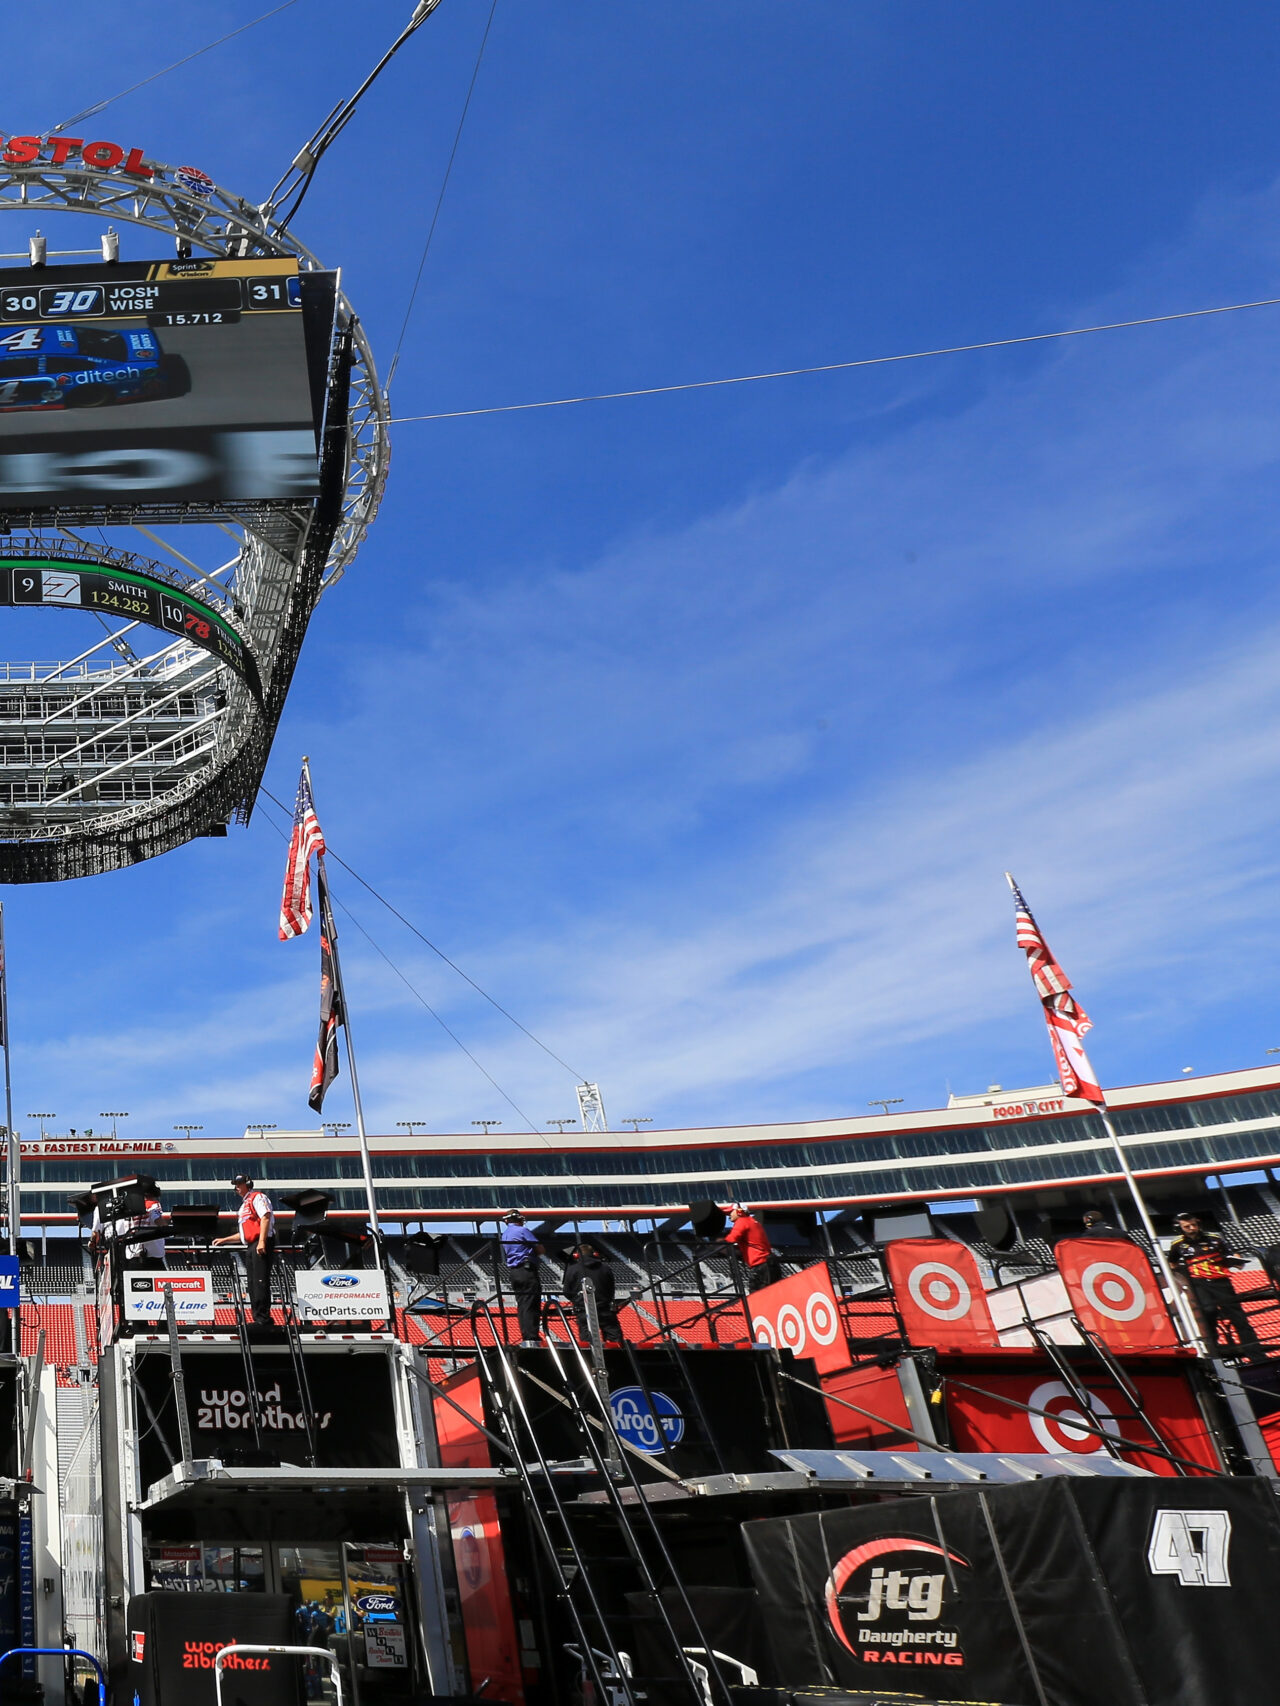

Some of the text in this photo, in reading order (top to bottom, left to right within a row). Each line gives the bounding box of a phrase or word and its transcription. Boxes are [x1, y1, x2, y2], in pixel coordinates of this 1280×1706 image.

[172, 263, 198, 272] Sprint
[109, 287, 159, 299] JOSH
[253, 285, 280, 300] 31
[6, 297, 36, 311] 30
[47, 291, 98, 314] 30
[111, 299, 154, 311] WISE
[166, 313, 223, 325] 15.712
[0, 328, 42, 350] 4
[75, 367, 140, 384] ditech
[22, 578, 34, 592] 9
[108, 580, 148, 598] SMITH
[91, 591, 150, 615] 124.282
[165, 605, 182, 622] 10
[185, 613, 210, 638] 78
[993, 1105, 1023, 1118] FOOD
[1039, 1100, 1064, 1112] CITY
[44, 1143, 96, 1153] FASTEST
[99, 1142, 161, 1152] HALF-MILE
[158, 1281, 201, 1289] Mtorcraft
[328, 1276, 353, 1286] Ford
[180, 1301, 208, 1310] Lane
[304, 1306, 384, 1316] FordParts.com
[1148, 1509, 1232, 1587] 47
[857, 1568, 945, 1621] jtg
[366, 1597, 395, 1610] Ford
[858, 1629, 957, 1647] Daugherty
[863, 1651, 963, 1666] RACING
